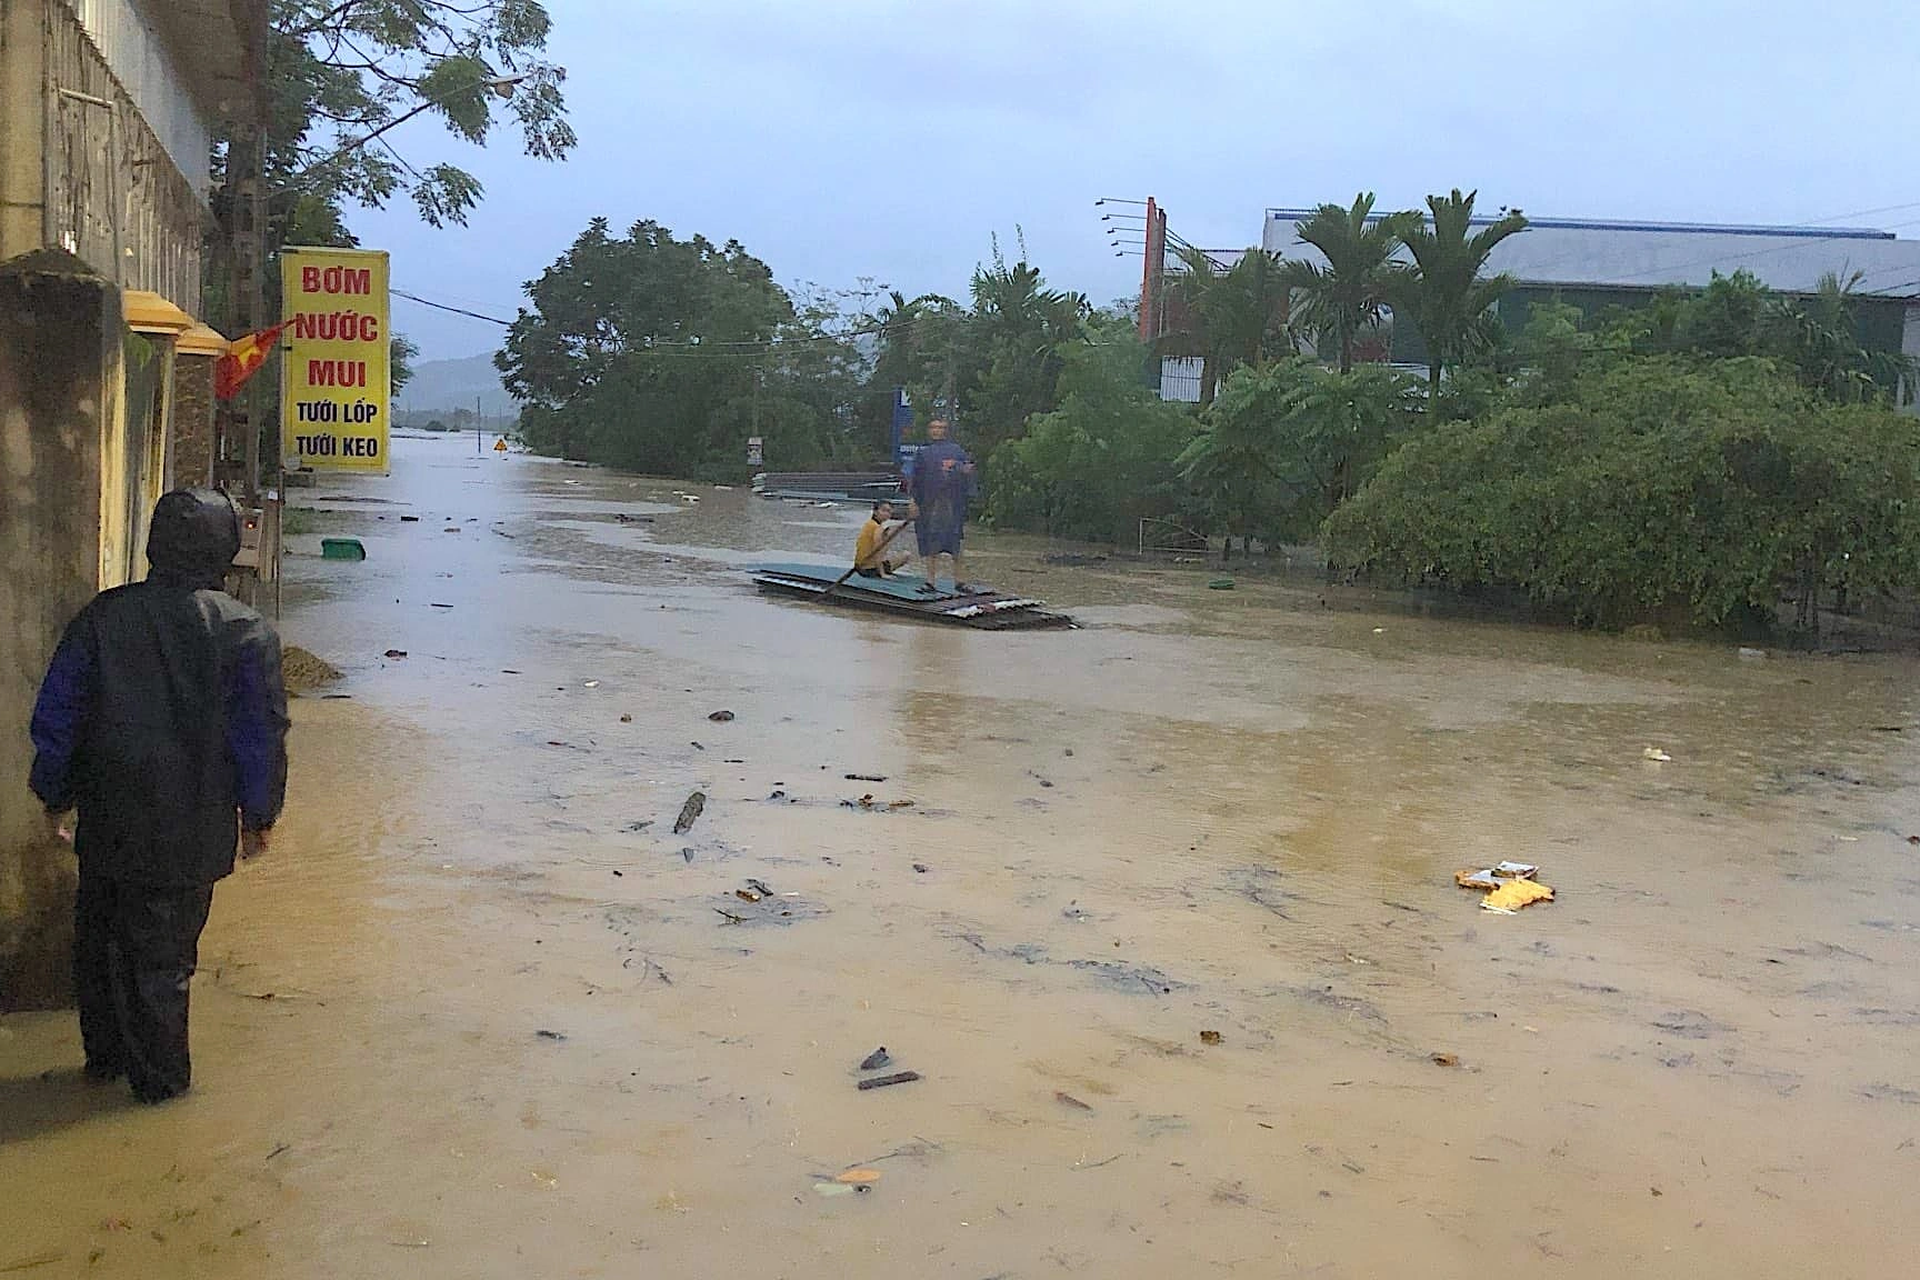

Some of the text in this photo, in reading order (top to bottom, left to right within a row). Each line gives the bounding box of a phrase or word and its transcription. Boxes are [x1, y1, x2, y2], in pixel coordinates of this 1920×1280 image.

[302, 265, 371, 295] BƠM
[295, 309, 378, 342] NƯỚC
[308, 360, 366, 387] MUI
[297, 396, 378, 424] TƯỚI LỐP
[296, 433, 378, 457] TƯỚI KEO
